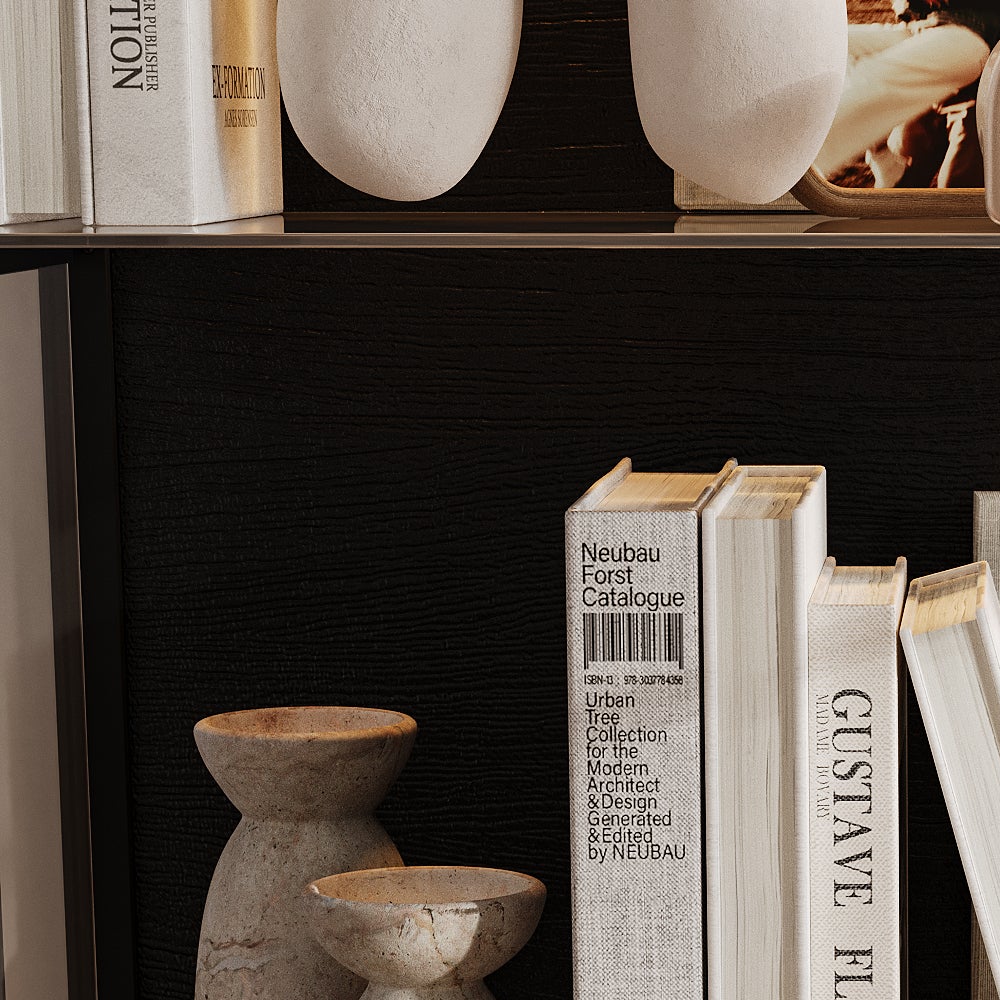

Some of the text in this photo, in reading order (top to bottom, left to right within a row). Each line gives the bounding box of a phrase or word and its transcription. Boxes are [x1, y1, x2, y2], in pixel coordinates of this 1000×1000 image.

[109, 0, 144, 92] TION
[144, 16, 158, 92] PUBLISHER
[212, 64, 266, 100] EX-FORMATION
[581, 542, 660, 562] Neubau
[582, 564, 634, 585] Forst
[582, 586, 685, 612] Catalogue
[584, 674, 614, 686] ISBN-13
[586, 690, 635, 708] Urban
[586, 708, 620, 725] Tree
[586, 726, 668, 742] Collection
[586, 741, 638, 759] for the
[816, 694, 830, 820] MADAME BOVARY
[587, 760, 649, 776] Modern
[587, 776, 660, 793] Architect
[832, 688, 872, 907] GUSTAVE
[588, 810, 672, 826] Generated
[588, 844, 686, 864] by NEUBAU
